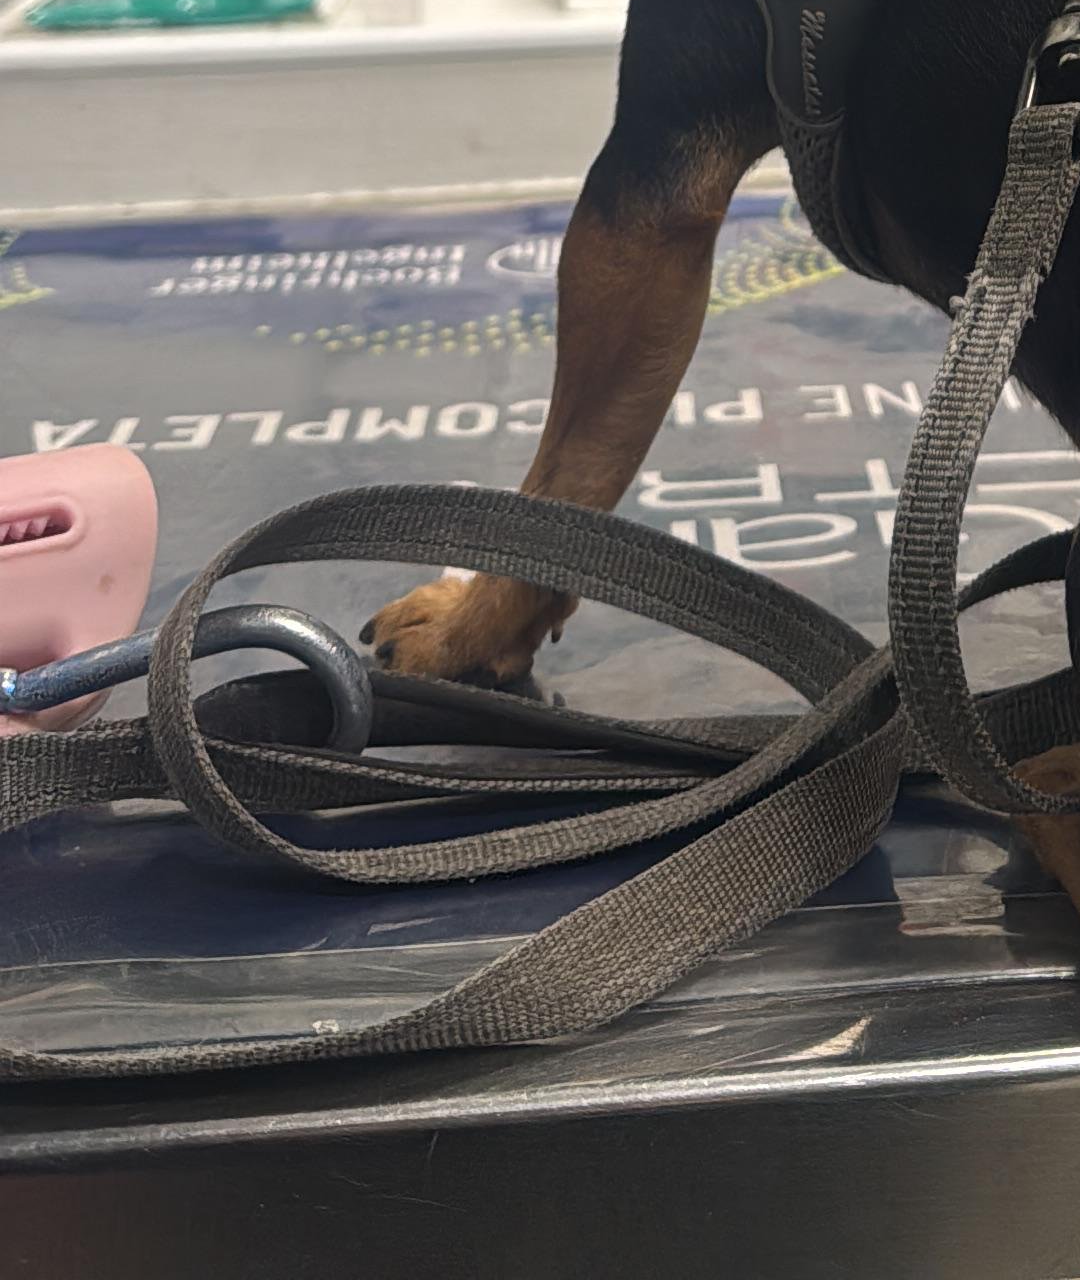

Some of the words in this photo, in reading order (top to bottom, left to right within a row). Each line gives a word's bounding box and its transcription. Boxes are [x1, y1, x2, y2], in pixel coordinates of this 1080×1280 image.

[190, 243, 467, 274] Ingelheim
[151, 263, 464, 297] Boehringer
[31, 397, 552, 454] COMPLETA
